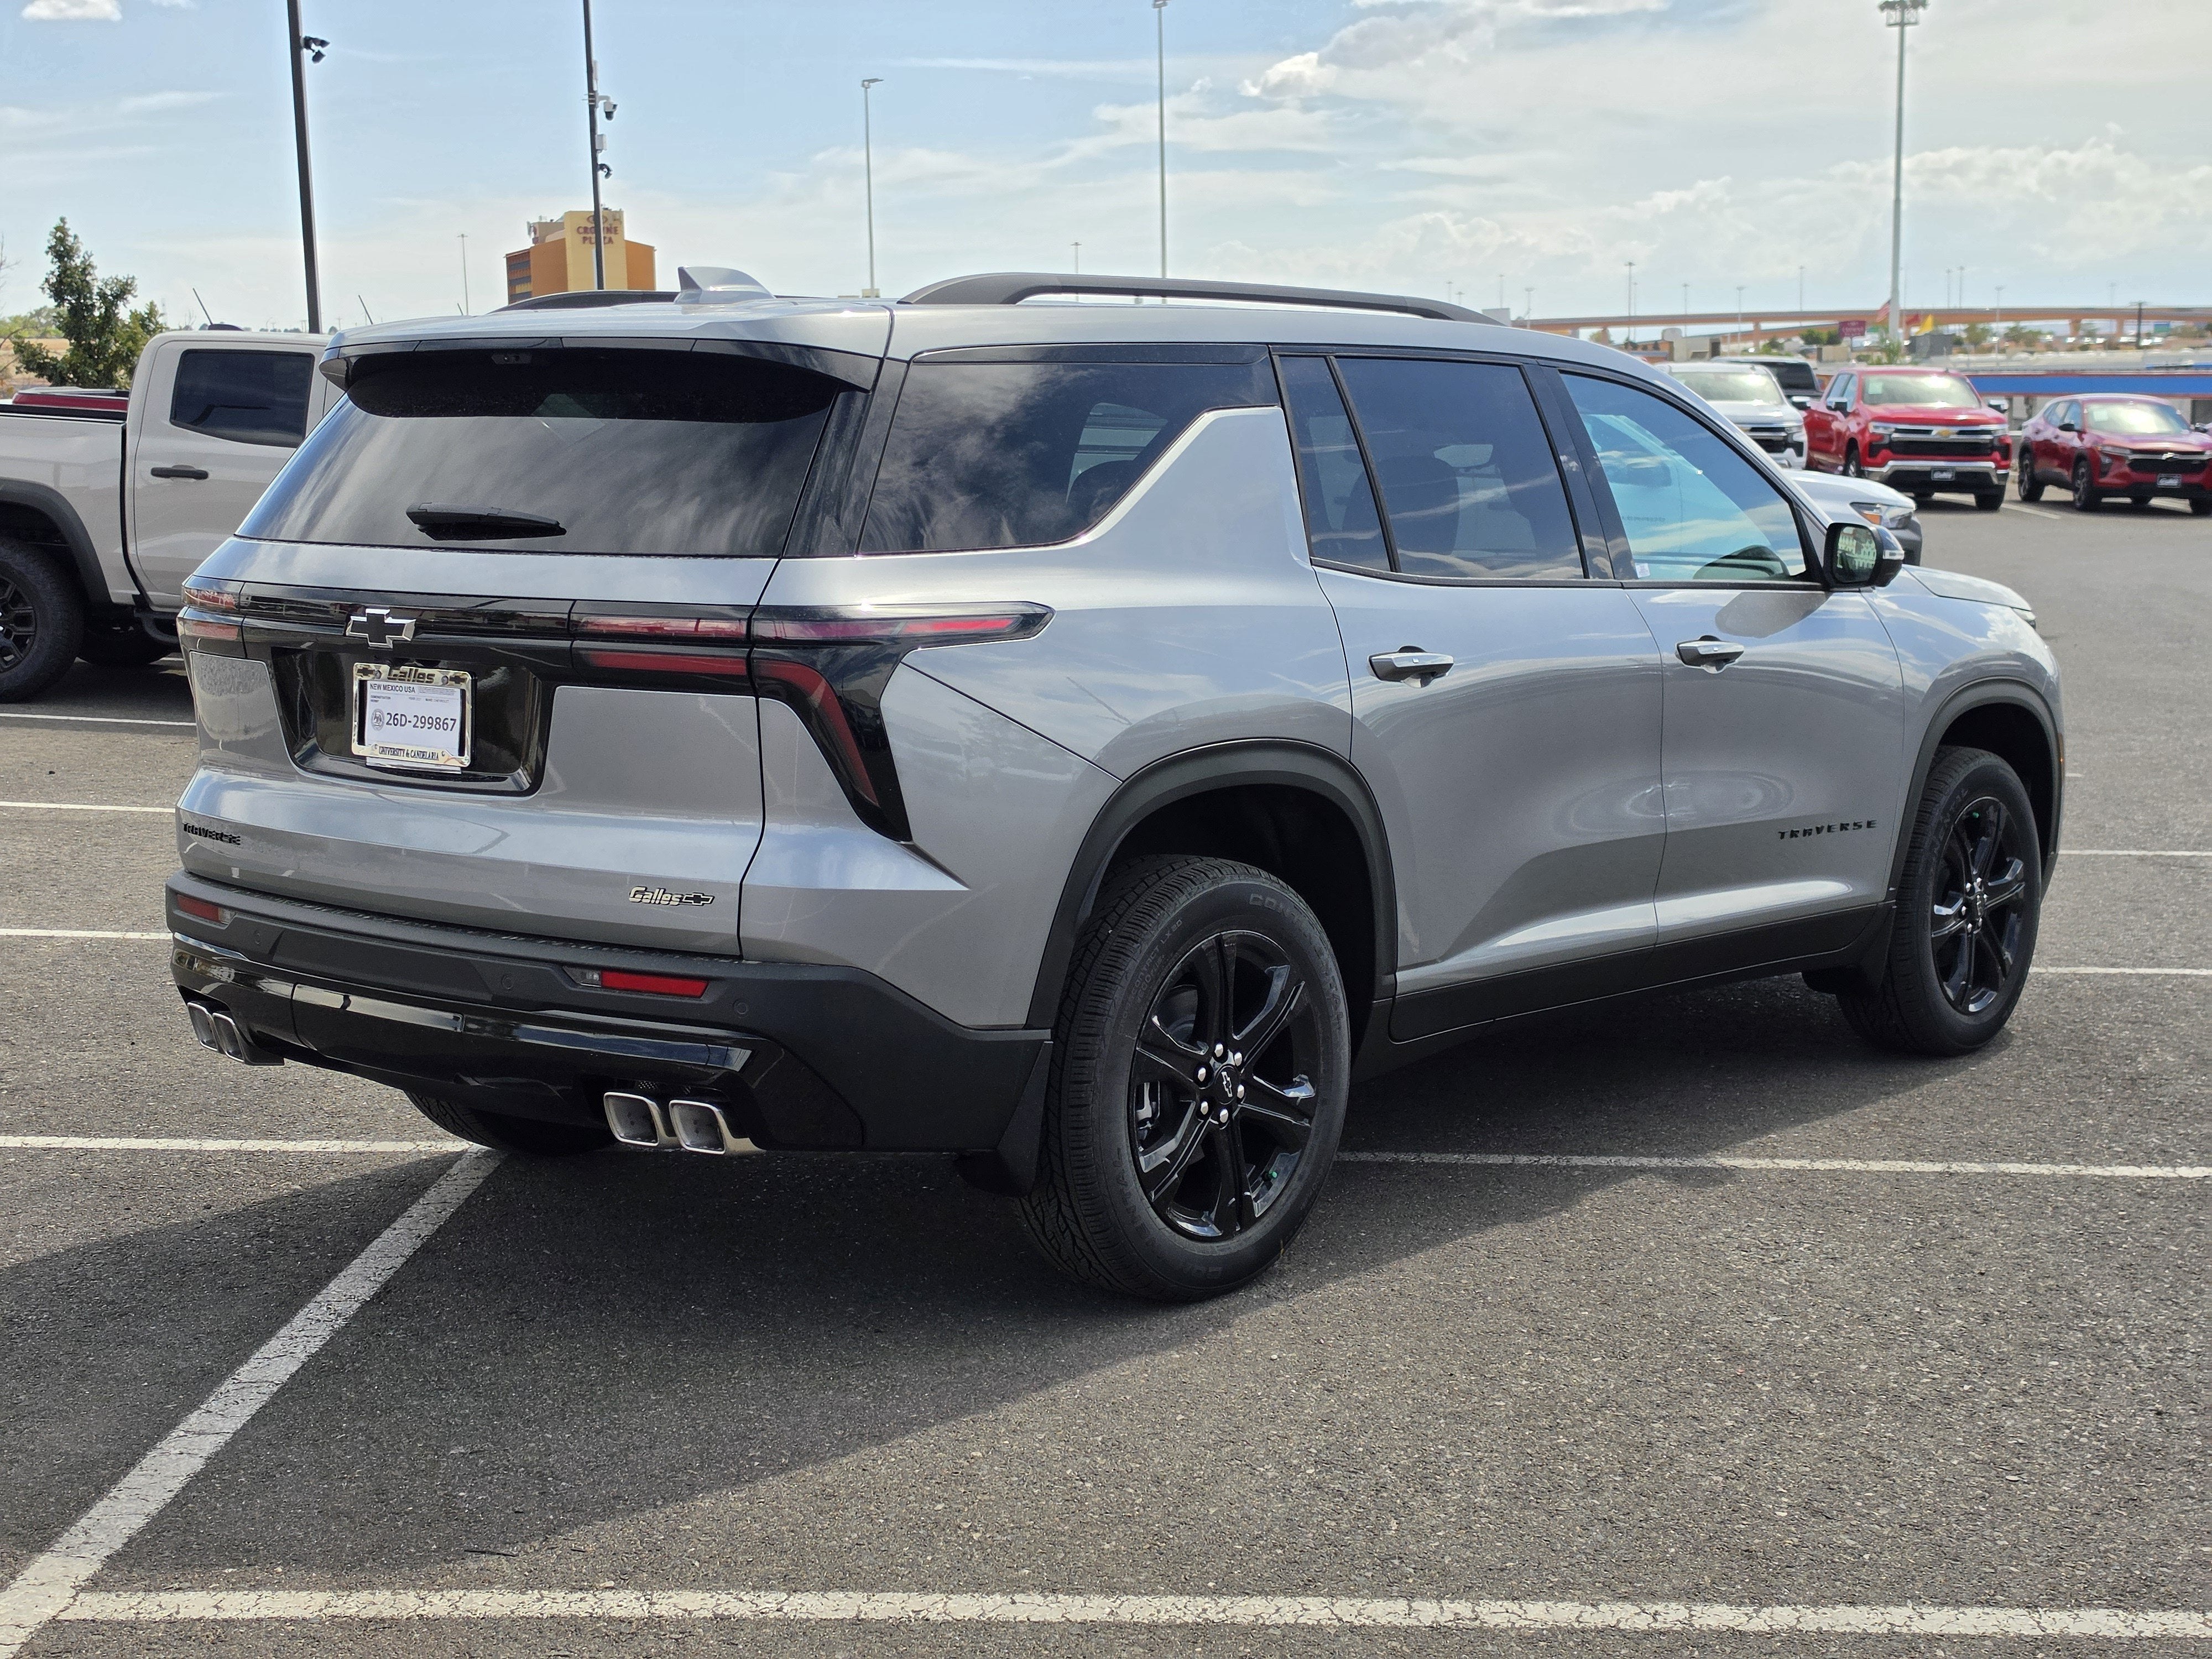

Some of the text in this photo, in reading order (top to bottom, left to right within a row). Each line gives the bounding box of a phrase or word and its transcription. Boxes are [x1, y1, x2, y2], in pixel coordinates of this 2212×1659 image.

[577, 226, 619, 234] CRONE
[582, 236, 613, 244] PLZA
[383, 684, 403, 692] MEXICO
[385, 712, 457, 731] 26D-299867
[379, 746, 405, 757] UNIVERSITY
[1778, 820, 1877, 840] TRAVERSE
[629, 886, 684, 906] Galles
